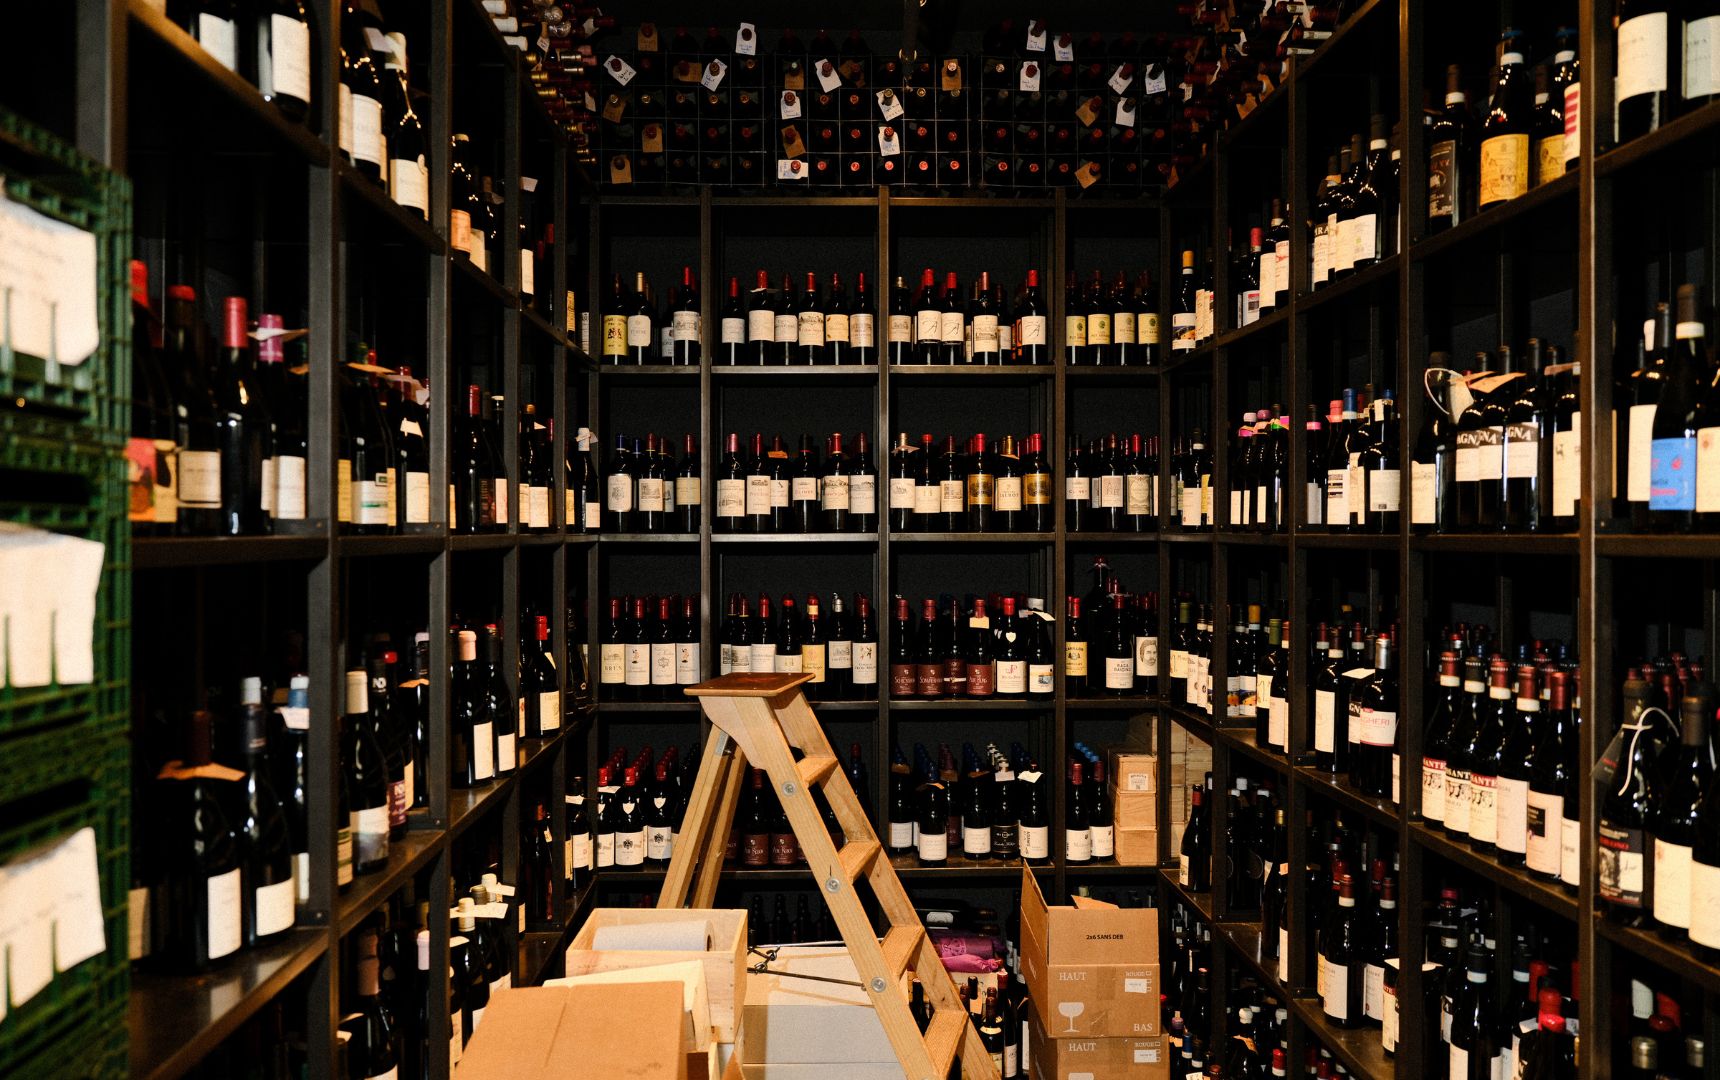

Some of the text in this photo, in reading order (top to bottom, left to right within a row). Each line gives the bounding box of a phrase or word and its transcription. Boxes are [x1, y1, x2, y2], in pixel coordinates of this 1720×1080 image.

[1059, 972, 1086, 981] HAUT
[1133, 1023, 1153, 1032] BAS
[1069, 1042, 1097, 1052] HAUT
